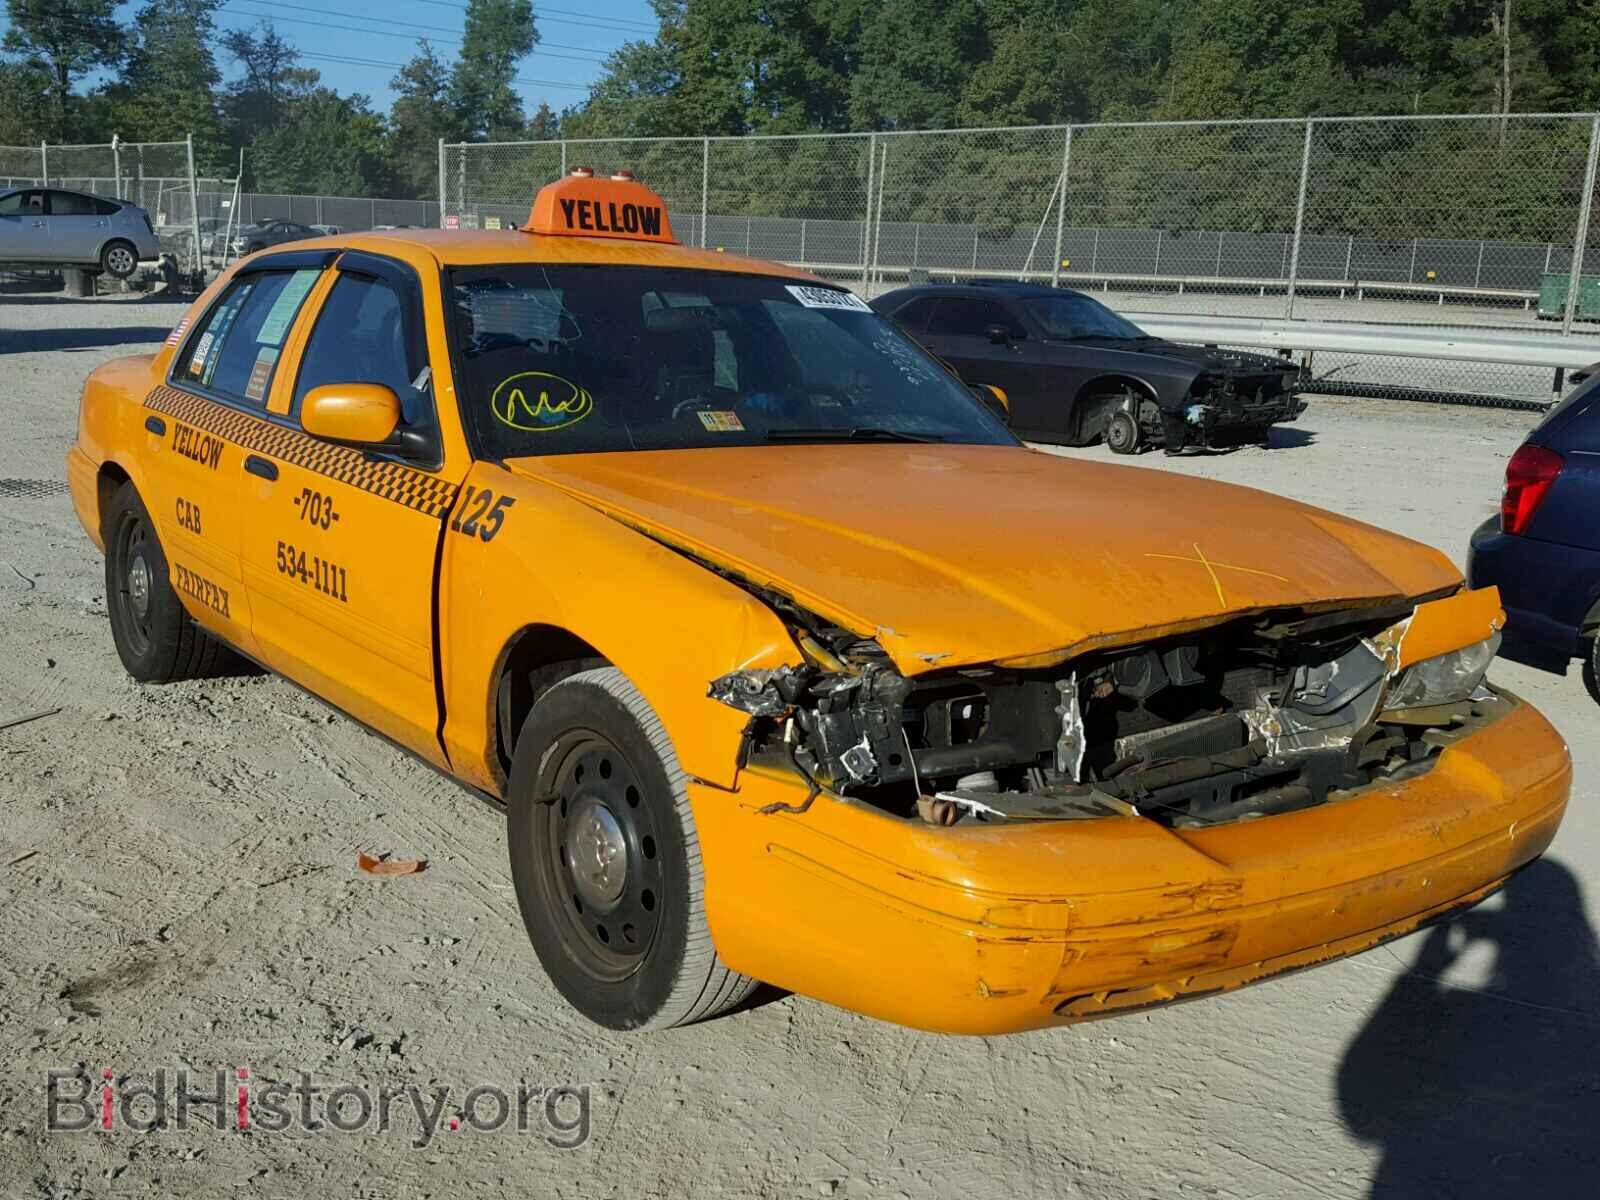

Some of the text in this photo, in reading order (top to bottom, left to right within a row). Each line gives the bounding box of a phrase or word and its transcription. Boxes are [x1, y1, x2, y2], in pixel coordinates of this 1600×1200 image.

[560, 199, 660, 235] YELLOW
[171, 423, 224, 471] YELLOW
[176, 497, 201, 535] CAB
[451, 486, 517, 542] 125
[175, 563, 231, 618] FAIRFAX
[277, 541, 348, 602] 534-1111
